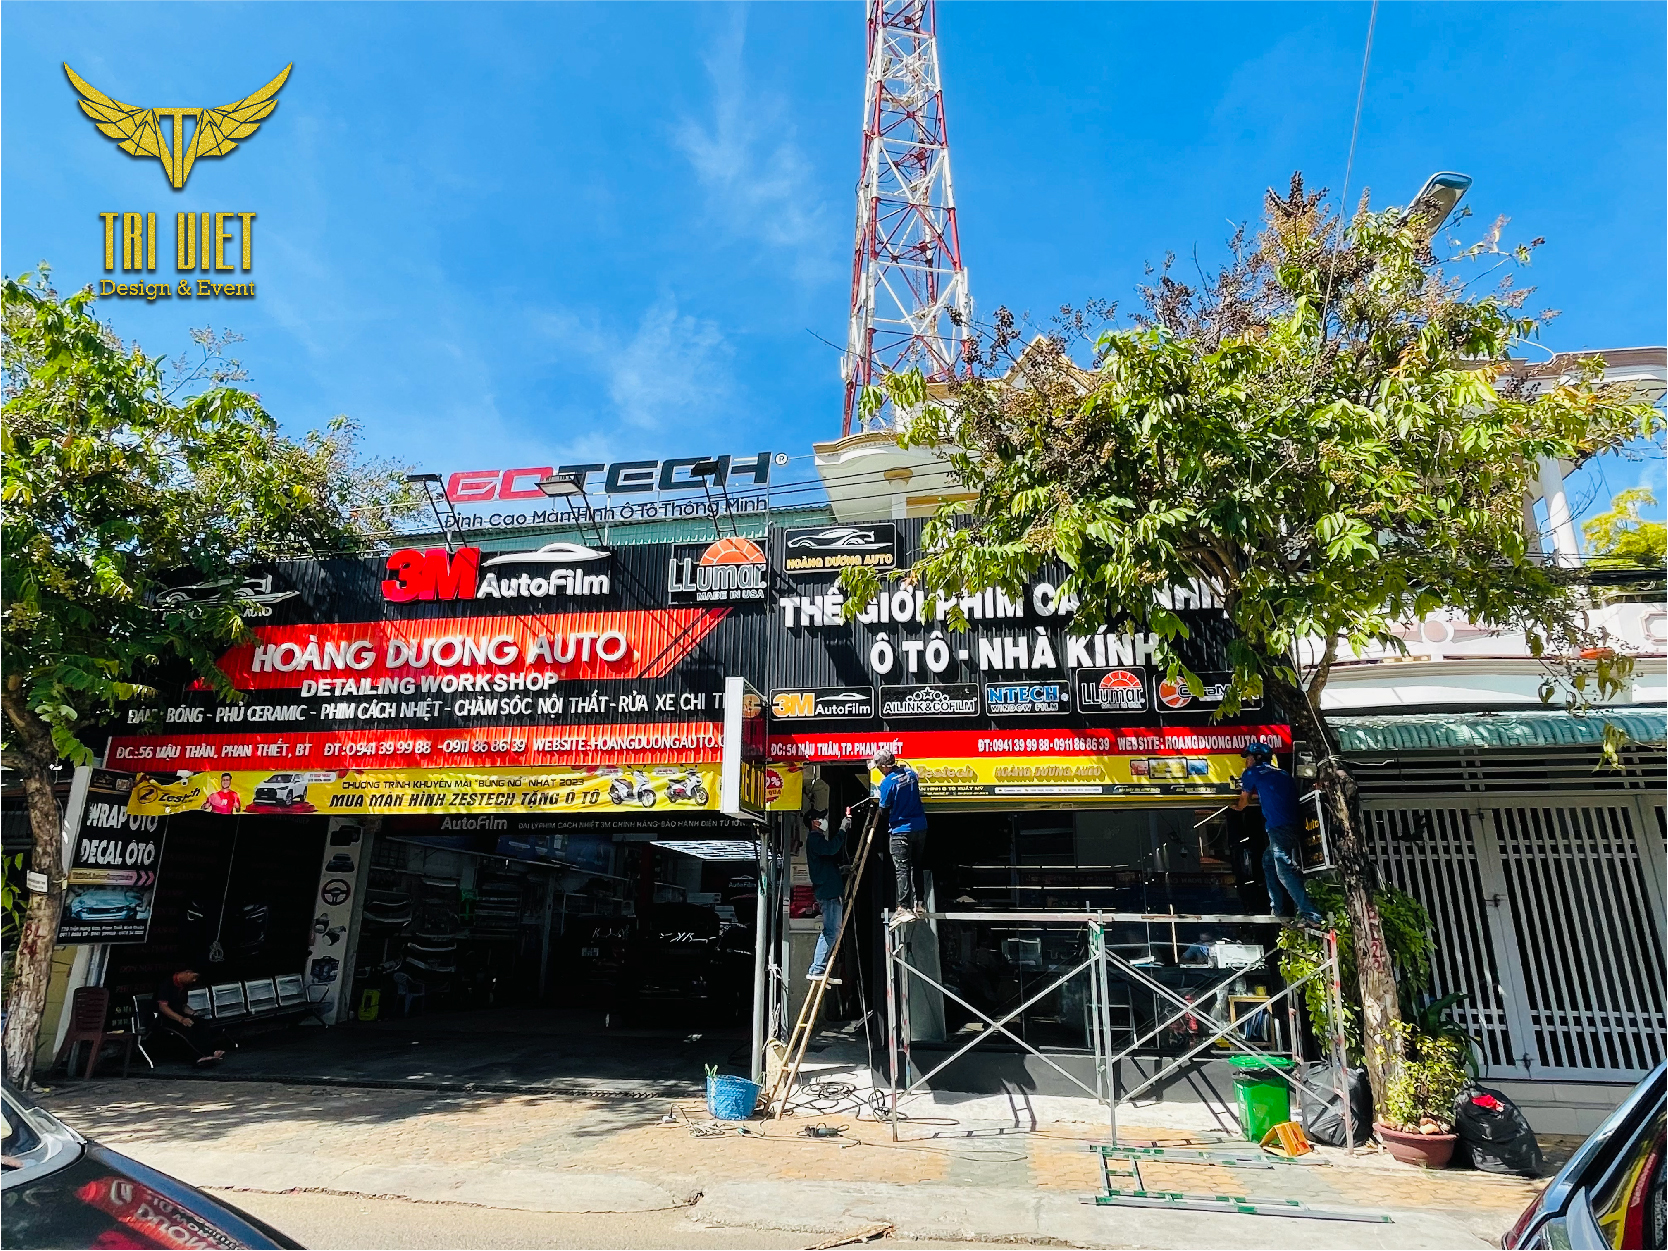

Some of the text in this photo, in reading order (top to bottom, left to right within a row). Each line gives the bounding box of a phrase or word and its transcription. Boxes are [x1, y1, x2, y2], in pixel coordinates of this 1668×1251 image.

[489, 512, 528, 527] Cao
[619, 501, 635, 520] Ô
[663, 500, 720, 521] Thông
[725, 496, 768, 513] Minh
[864, 553, 894, 566] AUTO
[381, 547, 481, 603] 3M
[477, 567, 611, 600] AutoFilm
[697, 590, 765, 601] MADE IN USA
[252, 630, 628, 672] HOÀNG DƯƠNG AUTO
[870, 631, 894, 675] Ô
[902, 629, 950, 673] TÔ
[979, 625, 1057, 671] NHÀ
[1067, 624, 1160, 668] KÍNH
[301, 671, 559, 698] DETAILING WORKSHOP
[987, 686, 1060, 704] NTECH
[216, 701, 245, 722] PHỦ
[247, 704, 308, 722] CERAMIC
[321, 701, 356, 720] PHIM
[357, 698, 397, 720] CÁCH
[400, 697, 443, 722] NHIỆT
[454, 695, 499, 716] CHĂM
[500, 694, 533, 715] SÓC
[537, 692, 564, 719] NỘI
[569, 689, 609, 714] THẤT
[619, 689, 649, 713] RỬA
[655, 692, 676, 712] XE
[681, 692, 706, 711] CHI
[773, 692, 816, 718] 3M
[815, 700, 871, 716] AutoFilm
[1035, 702, 1059, 712] FILM
[221, 744, 253, 758] PHAN
[295, 743, 313, 756] BT
[378, 741, 394, 755] 39
[396, 740, 413, 754] 99
[414, 740, 432, 754] 88
[472, 739, 489, 753] 86
[490, 739, 509, 753] 86
[511, 738, 527, 752] 39
[787, 743, 797, 756] 54
[854, 742, 877, 756] PHAN
[1014, 738, 1026, 752] 39
[1026, 738, 1038, 752] 99
[1074, 737, 1086, 751] 86
[1086, 737, 1097, 751] 86
[1099, 737, 1110, 751] 39
[559, 778, 585, 787] 2023
[329, 794, 364, 808] MUA
[368, 791, 403, 807] MÀN
[408, 791, 447, 807] HÌNH
[449, 791, 516, 806] ZESTECH
[520, 789, 560, 809] TẶNG
[581, 787, 600, 804] TÔ
[86, 802, 127, 829] WRAP
[441, 815, 508, 831] AutoFilm
[80, 838, 123, 866] DECAL
